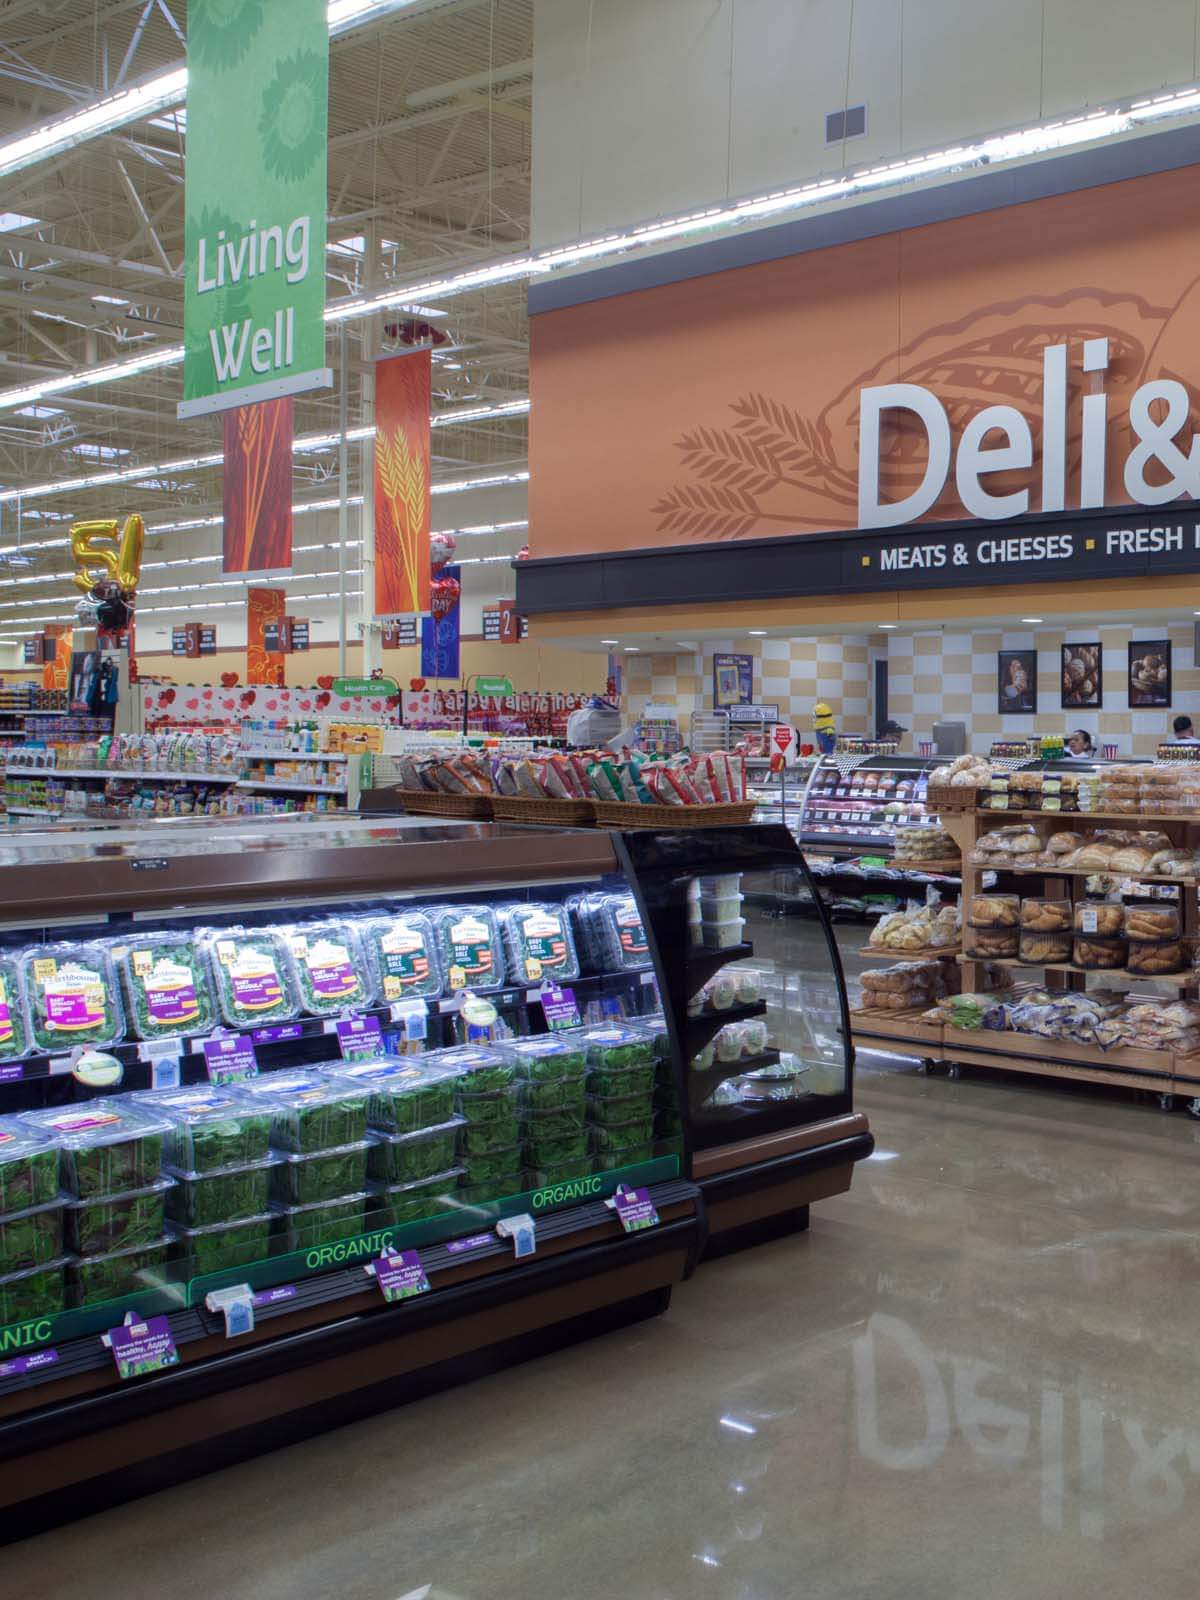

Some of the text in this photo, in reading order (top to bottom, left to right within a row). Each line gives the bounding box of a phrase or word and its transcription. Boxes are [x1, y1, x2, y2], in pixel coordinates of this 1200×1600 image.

[196, 215, 311, 296] Living
[208, 307, 294, 383] Well
[857, 337, 1108, 530] Deli
[880, 545, 947, 571] MEATS
[952, 544, 969, 567] &
[976, 535, 1073, 564] CHEESES
[1105, 526, 1184, 555] FRESH
[503, 610, 511, 635] 2
[532, 1177, 602, 1209] ORGANIC
[306, 1231, 394, 1269] ORGANIC
